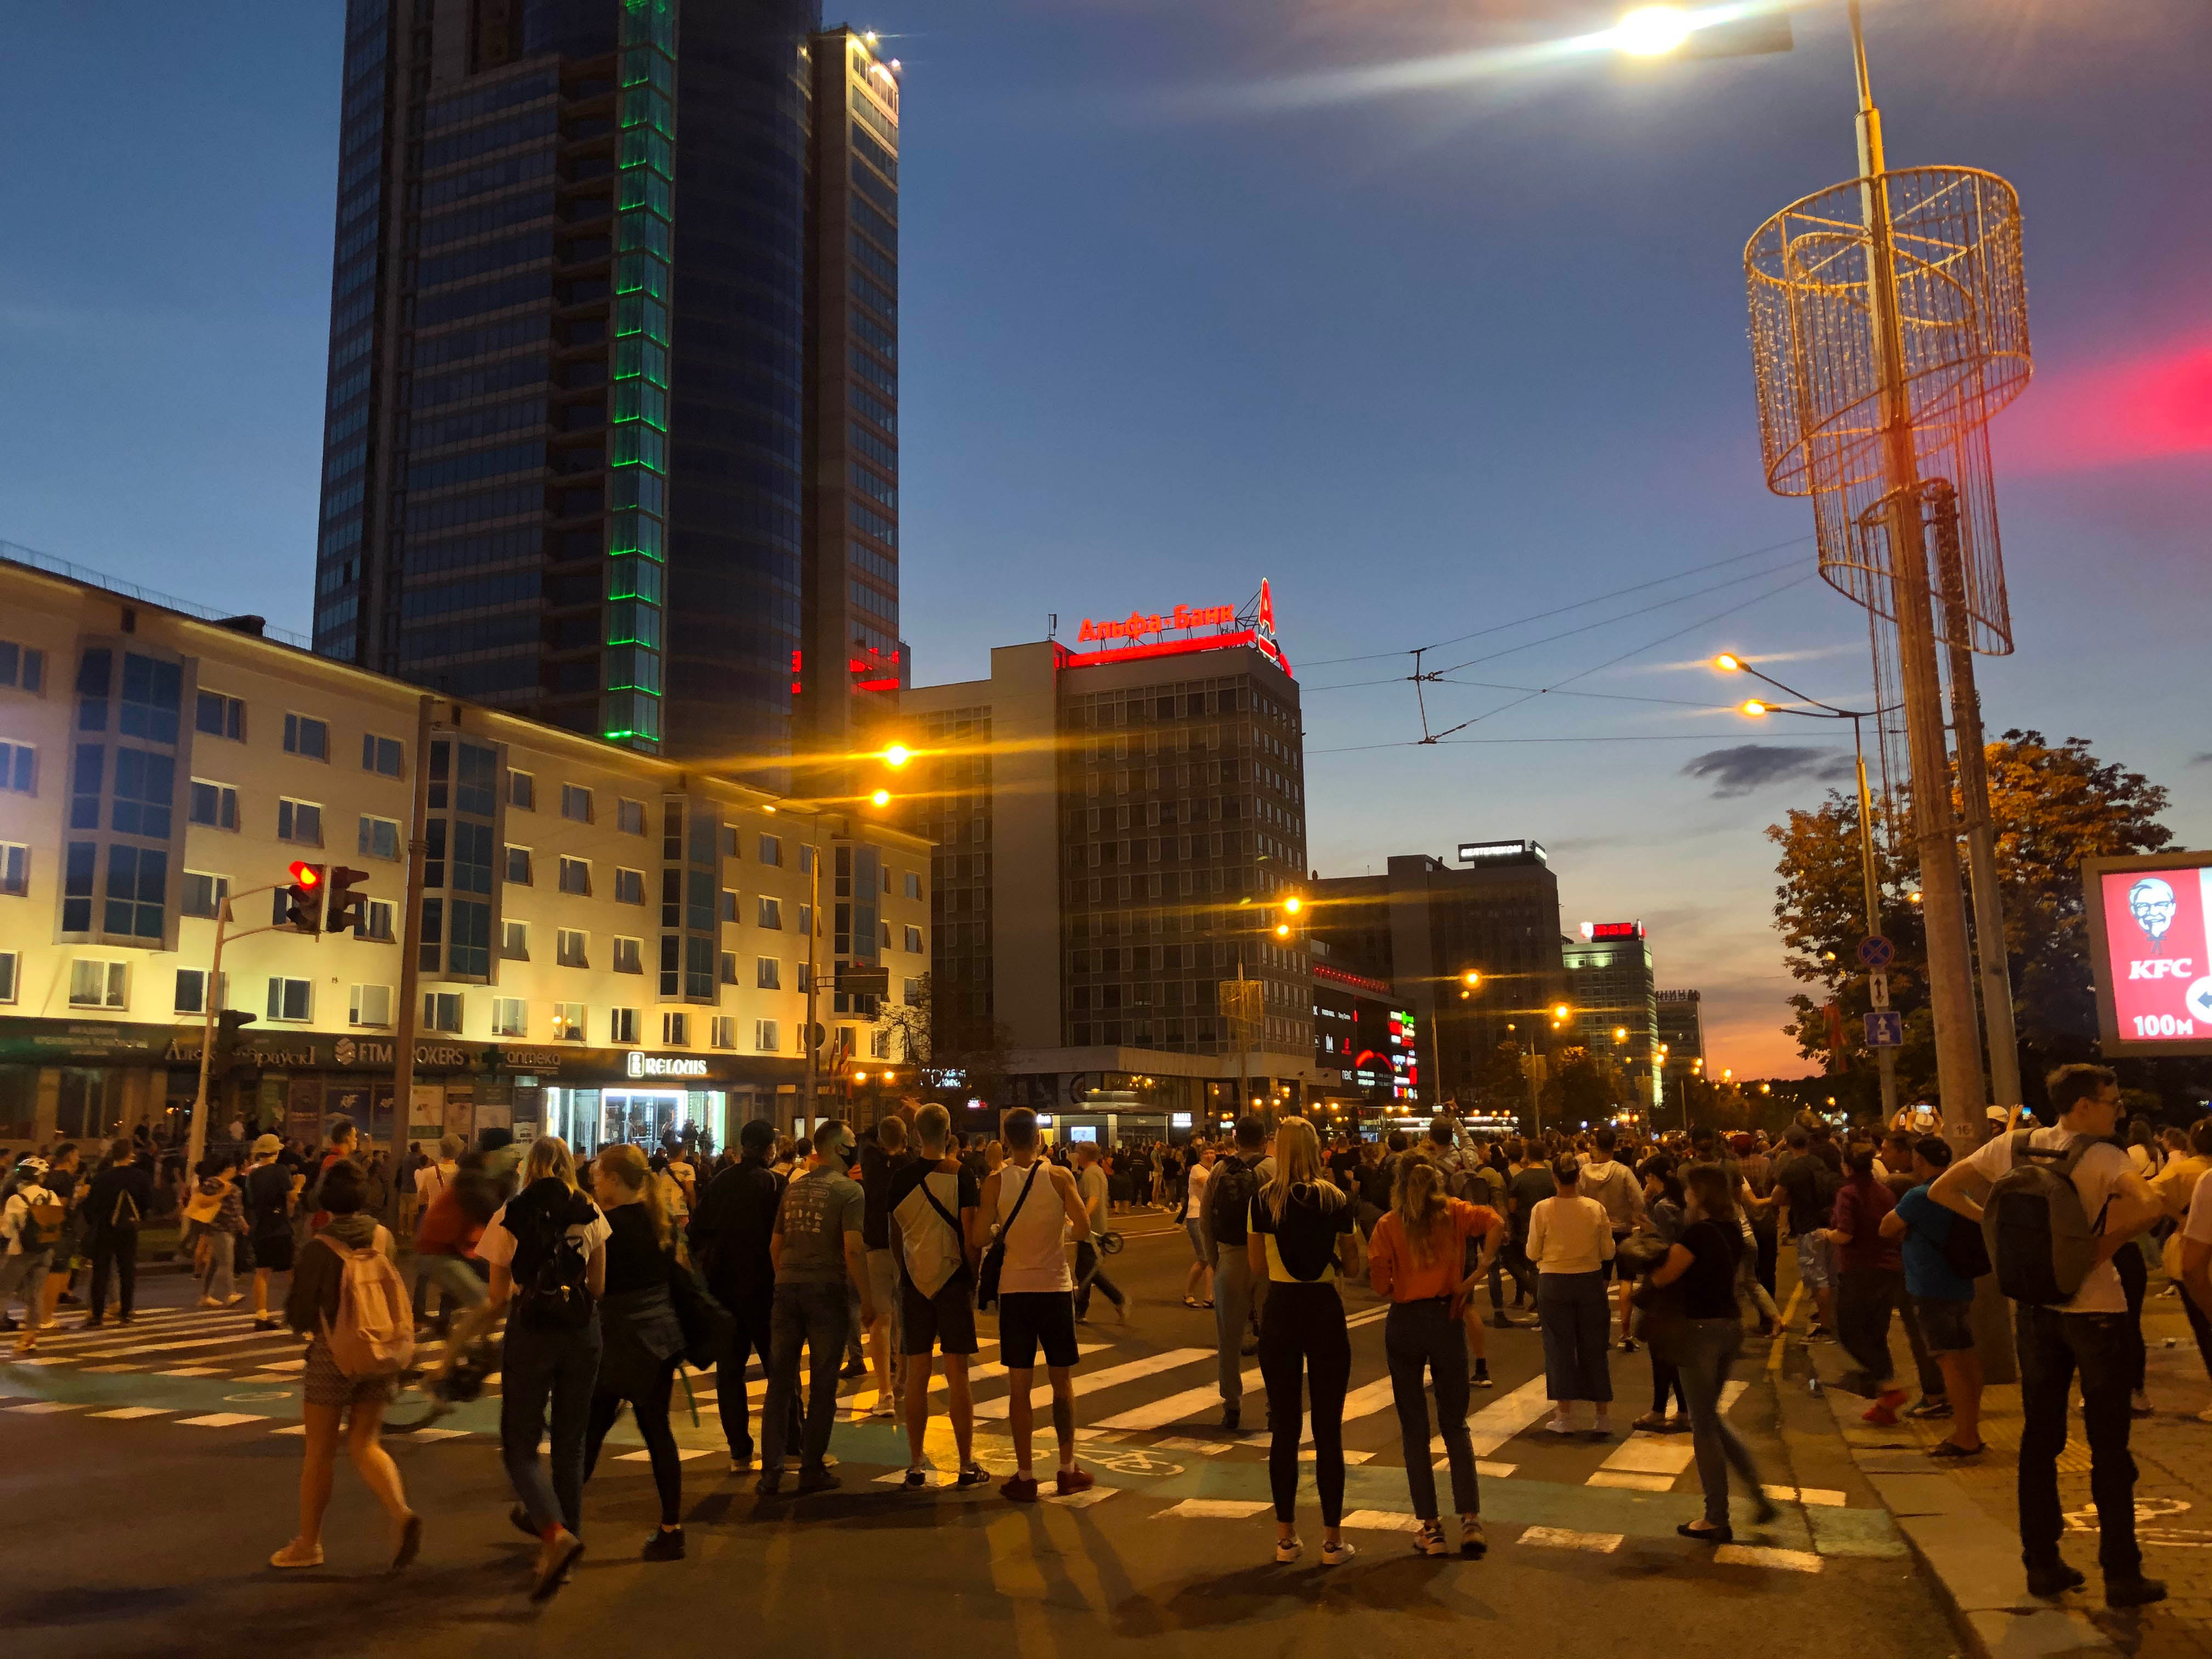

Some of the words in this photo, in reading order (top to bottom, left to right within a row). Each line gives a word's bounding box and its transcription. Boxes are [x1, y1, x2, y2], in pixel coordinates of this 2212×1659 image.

[2129, 958, 2192, 980] KFC
[359, 1042, 392, 1063] FTM
[413, 1046, 464, 1066] OKERS
[645, 1058, 707, 1075] RELOUIS
[1957, 1125, 1970, 1135] 16
